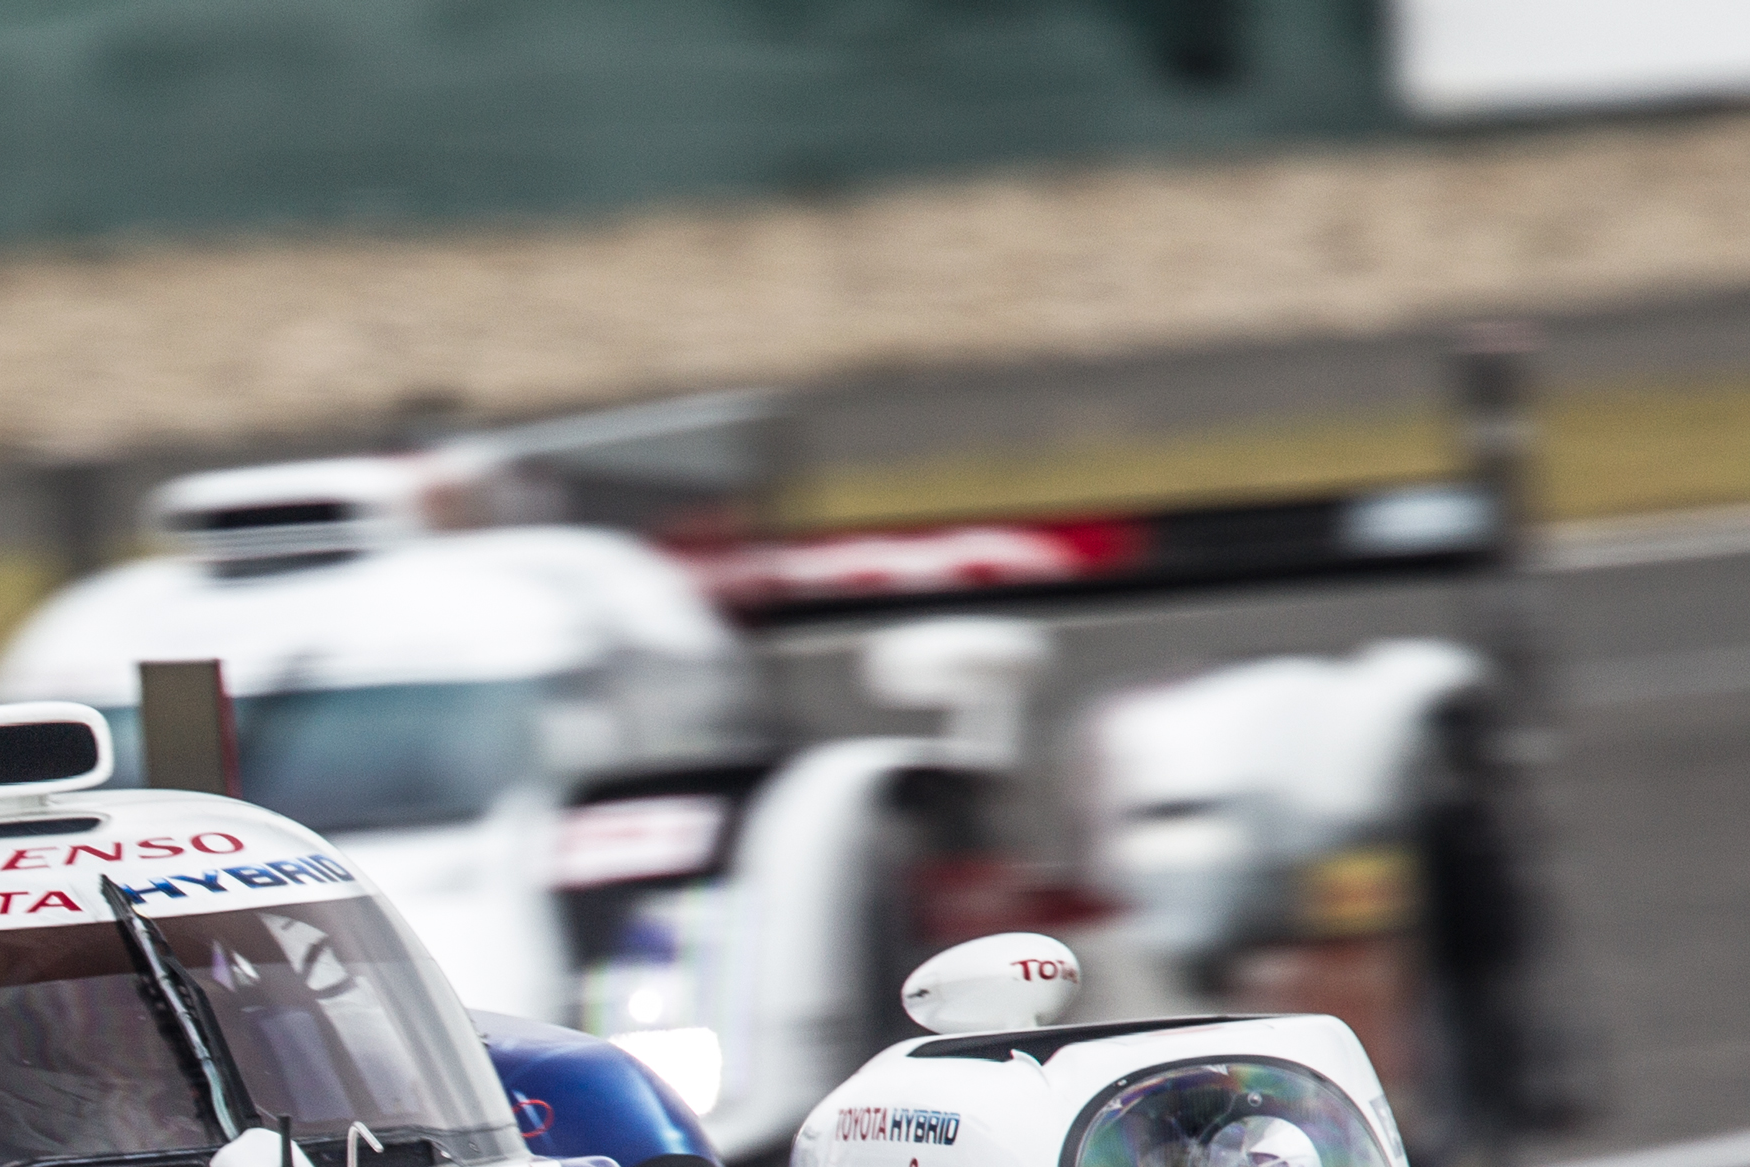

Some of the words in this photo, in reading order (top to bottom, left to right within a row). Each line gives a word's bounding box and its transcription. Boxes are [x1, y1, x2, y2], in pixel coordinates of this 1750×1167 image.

[118, 853, 357, 906] HYBRID
[835, 1106, 887, 1142] TOYOTA
[890, 1107, 961, 1146] HYBRID
